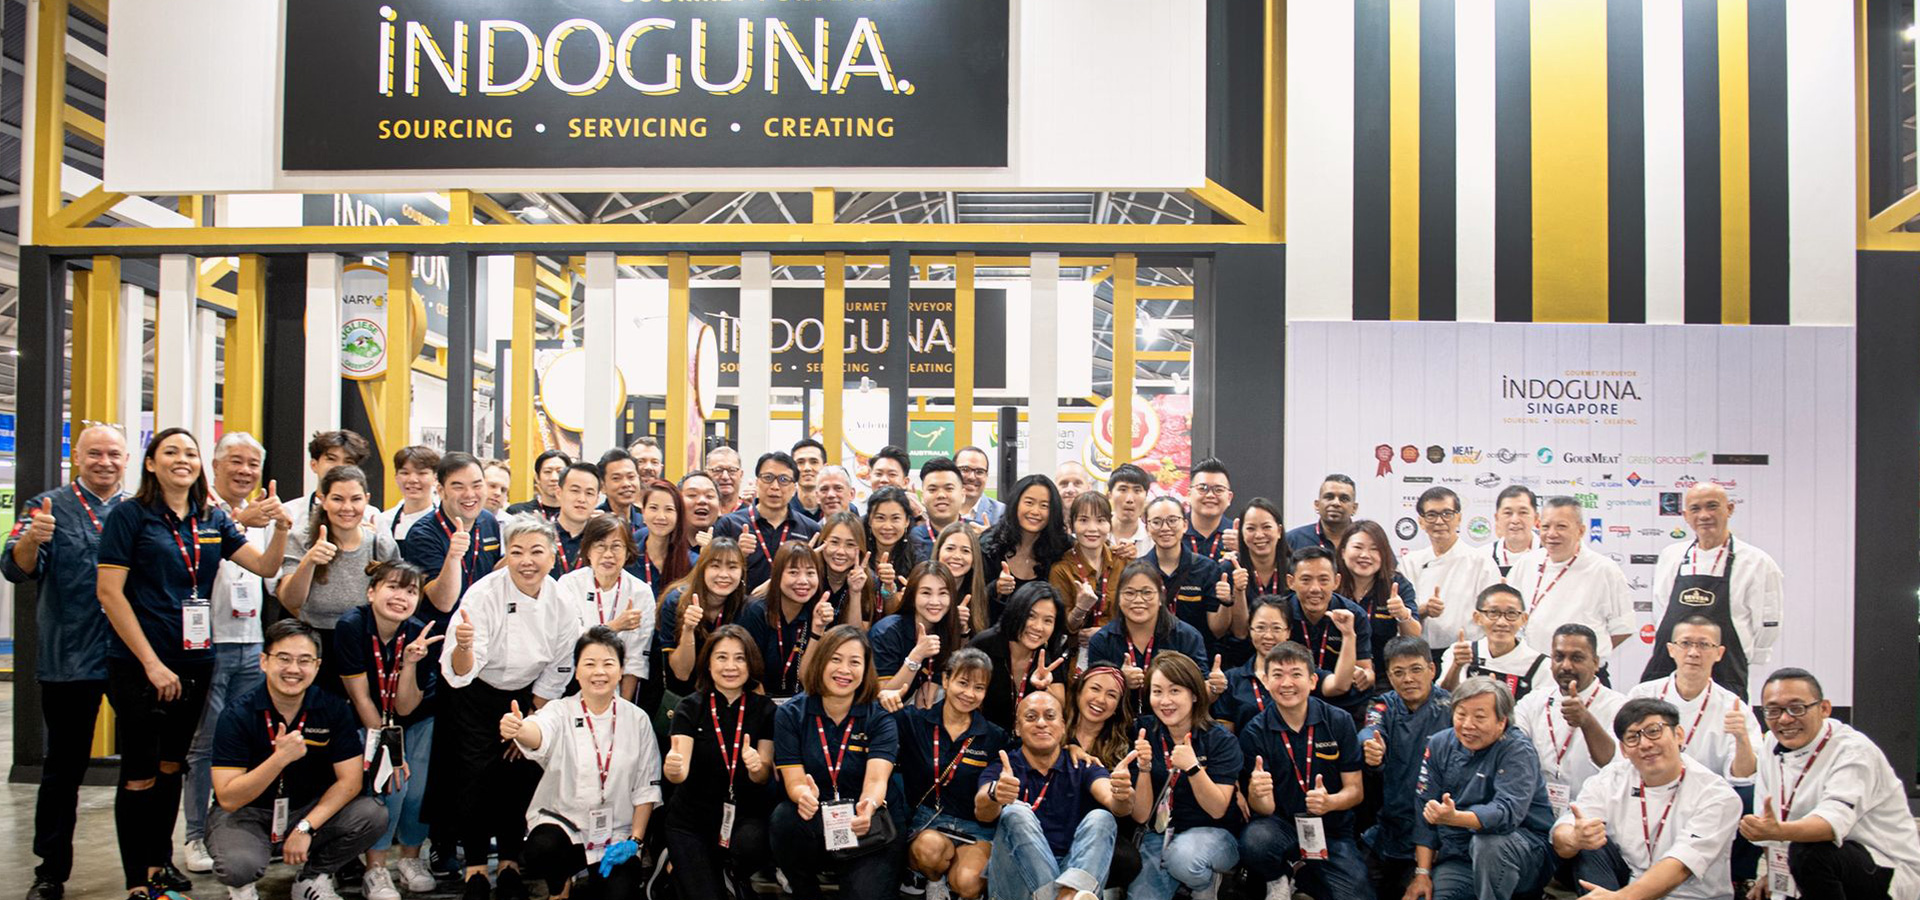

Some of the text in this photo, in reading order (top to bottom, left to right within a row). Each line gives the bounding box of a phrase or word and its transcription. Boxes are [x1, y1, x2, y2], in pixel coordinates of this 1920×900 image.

[378, 117, 895, 139] SOURCING SERVICING CREATING
[342, 295, 372, 304] NARY
[846, 302, 953, 312] URMET RVEYOR
[910, 363, 953, 373] EATING
[1527, 402, 1619, 415] SINGAPORE
[1603, 418, 1637, 426] CREATING
[1452, 446, 1474, 455] MEAT
